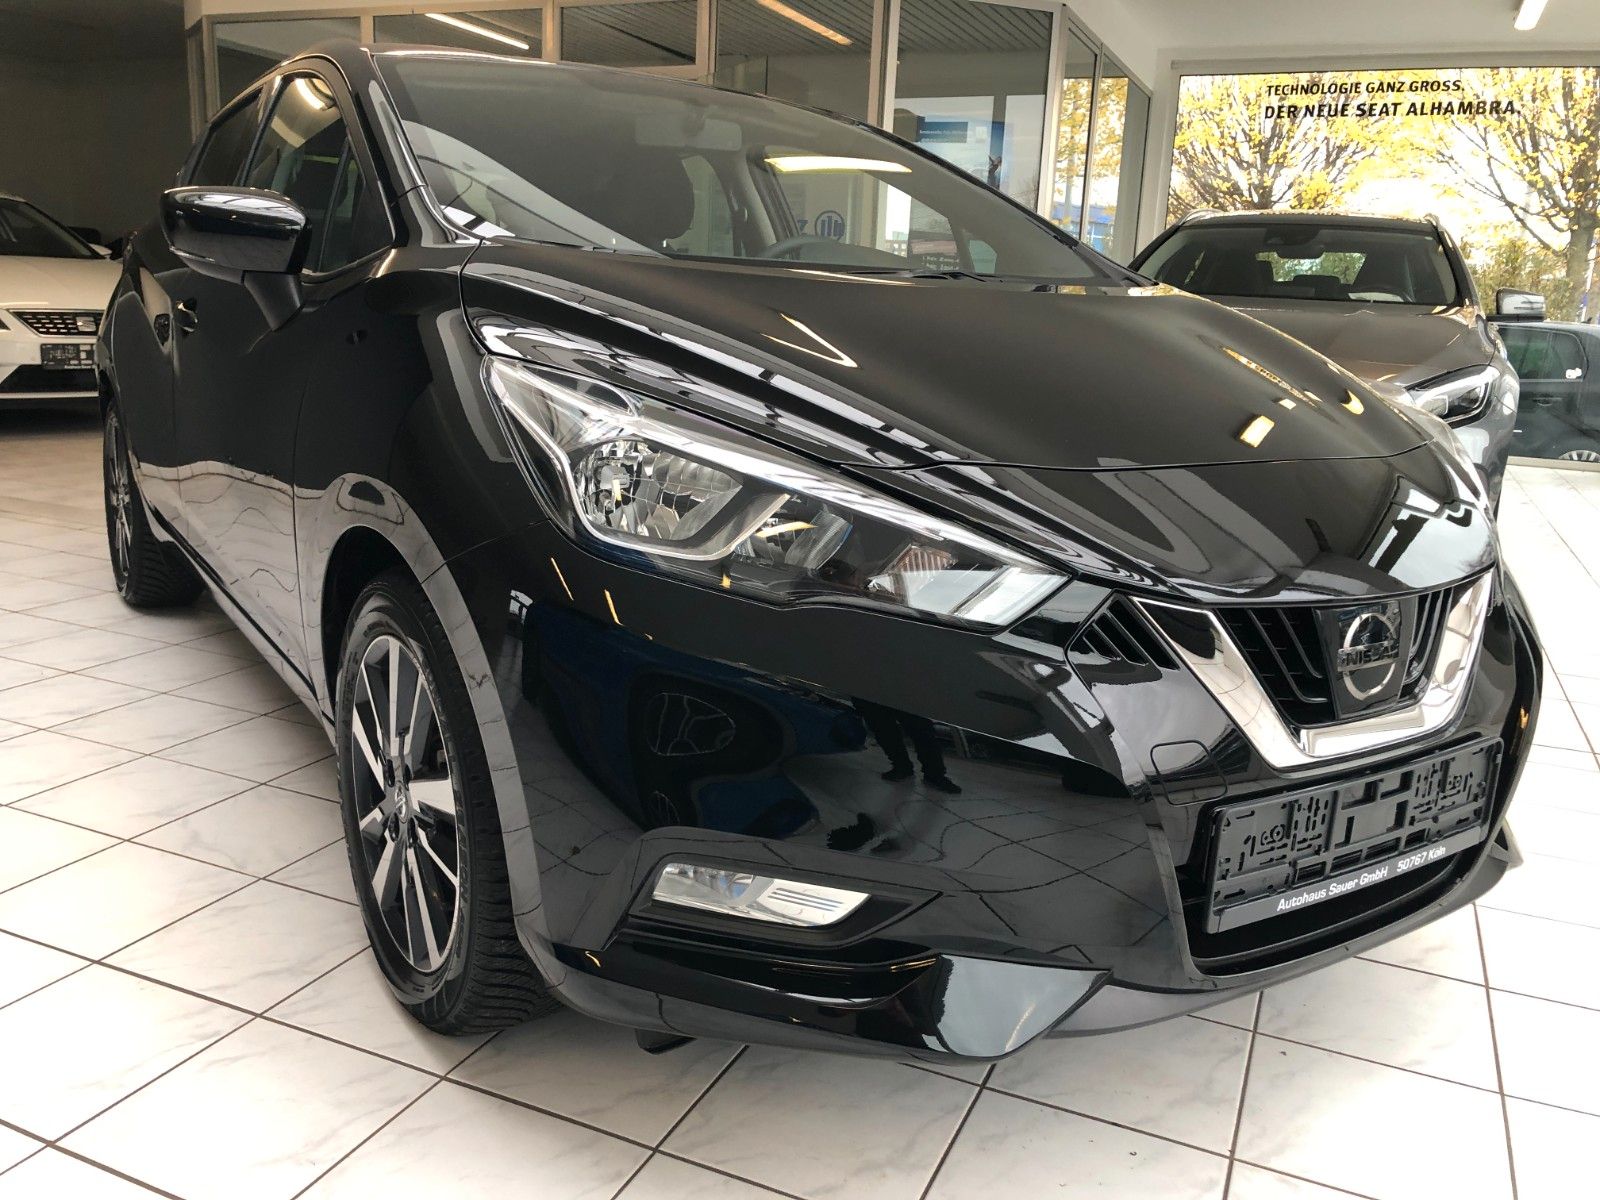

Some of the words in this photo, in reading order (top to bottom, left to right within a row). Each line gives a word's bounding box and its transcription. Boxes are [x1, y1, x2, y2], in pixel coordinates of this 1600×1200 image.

[1266, 82, 1361, 96] TECHNOLOGIE
[1365, 81, 1405, 94] GANZ
[1409, 80, 1465, 92] GROSS.
[1264, 104, 1298, 119] DER
[1302, 103, 1350, 117] NEUE
[1355, 102, 1402, 117] SEAT
[1406, 100, 1521, 116] ALHAMBRA.
[1276, 888, 1327, 912] Autohaus
[1328, 879, 1358, 896] Sauer
[1360, 867, 1389, 887] GmbH
[1396, 851, 1427, 872] 50767
